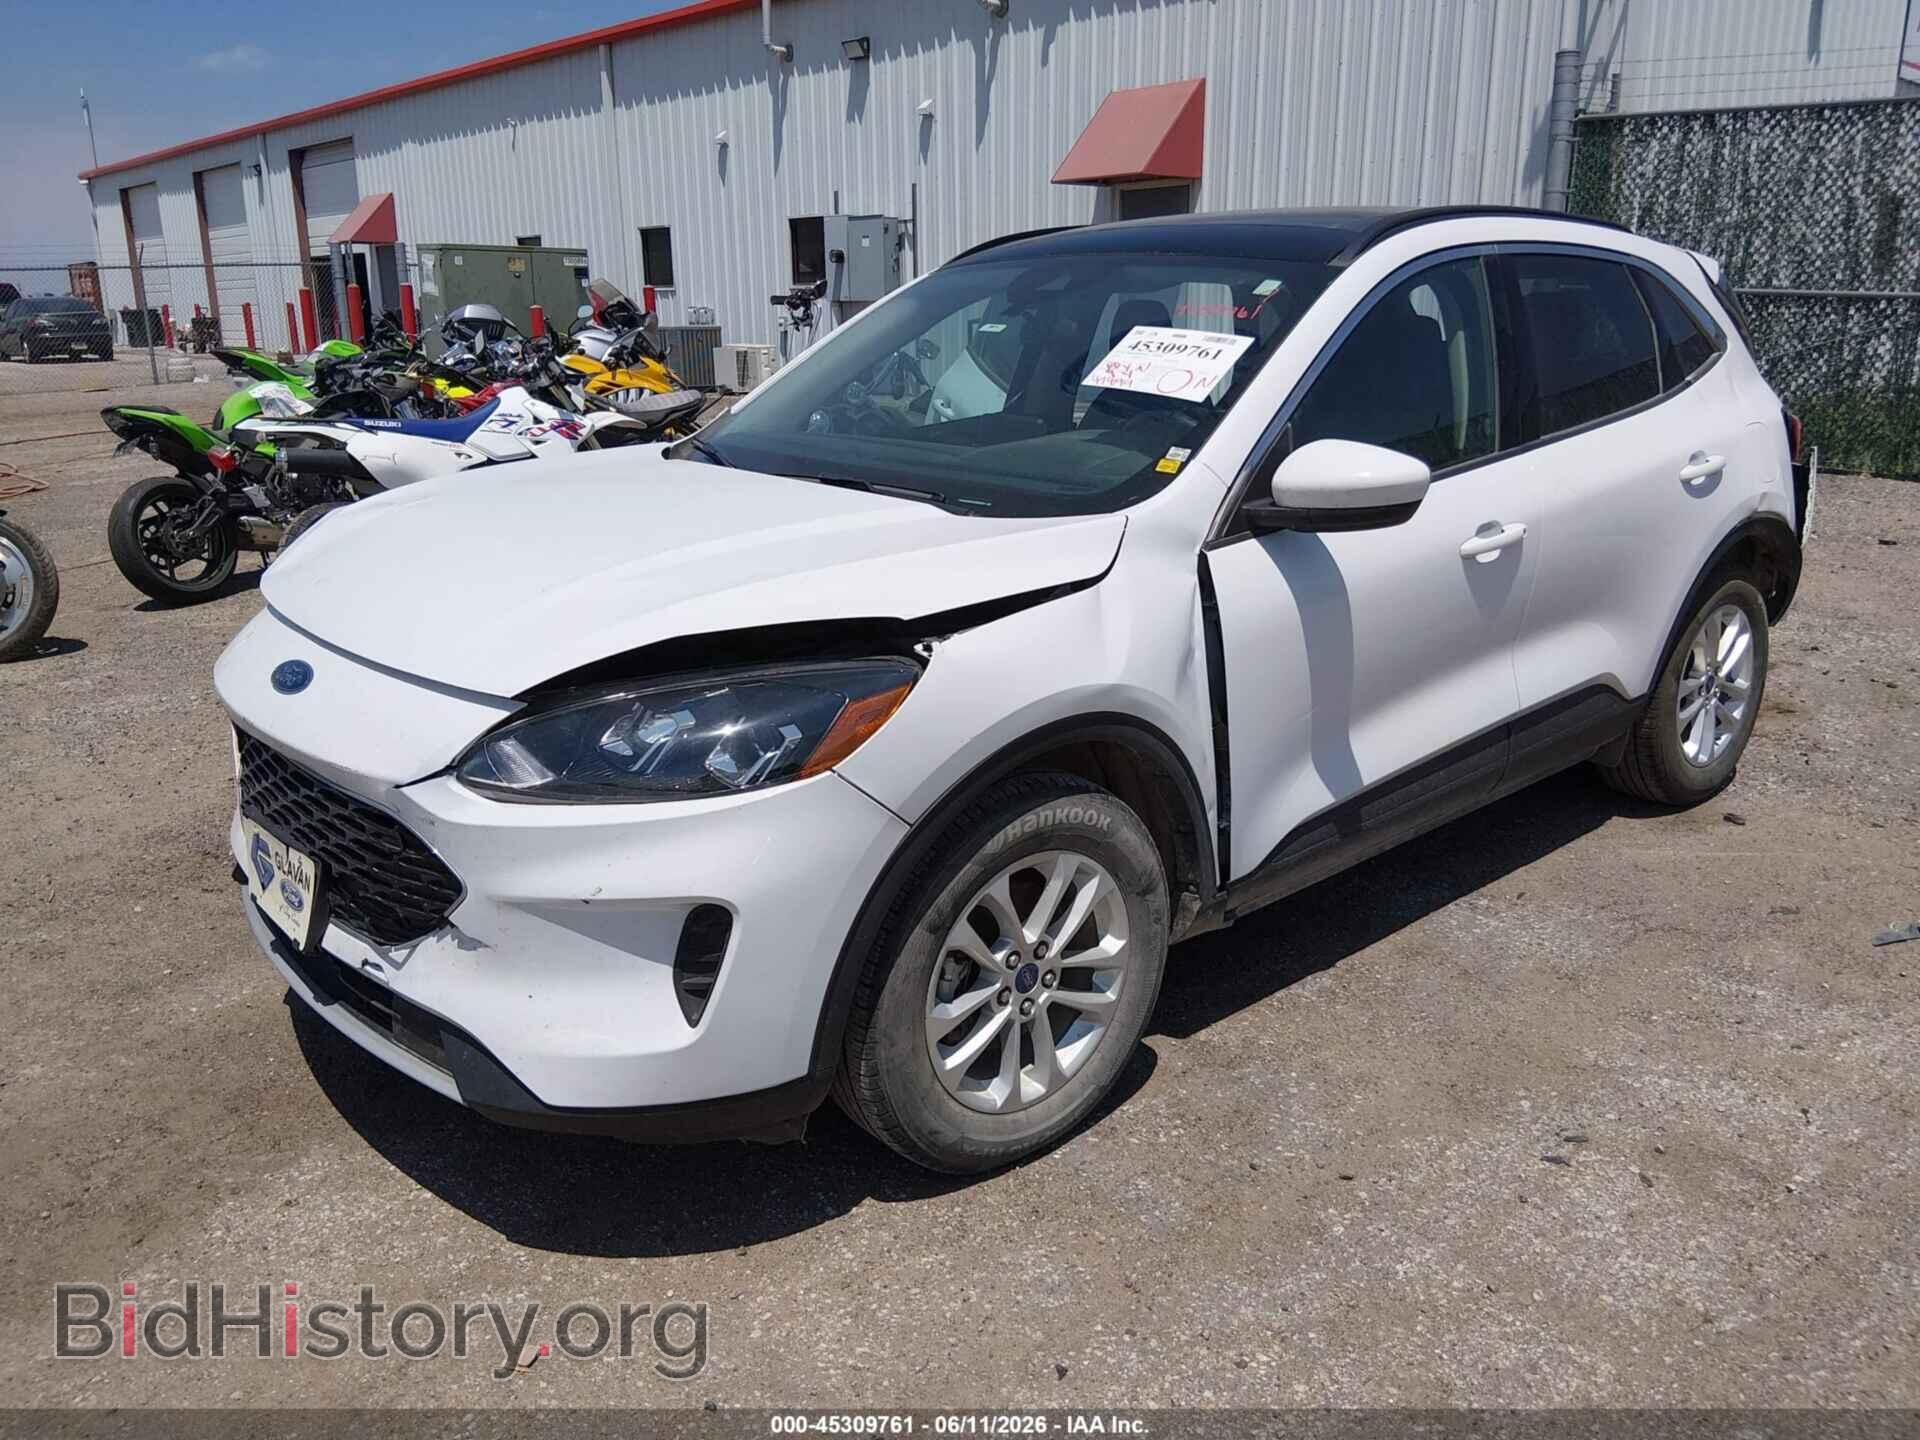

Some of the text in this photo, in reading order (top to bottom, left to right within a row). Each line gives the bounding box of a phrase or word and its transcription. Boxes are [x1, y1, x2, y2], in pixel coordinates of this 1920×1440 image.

[1128, 340, 1223, 360] 45309761
[364, 419, 401, 428] SUZUKI
[275, 851, 311, 894] GLAVAN
